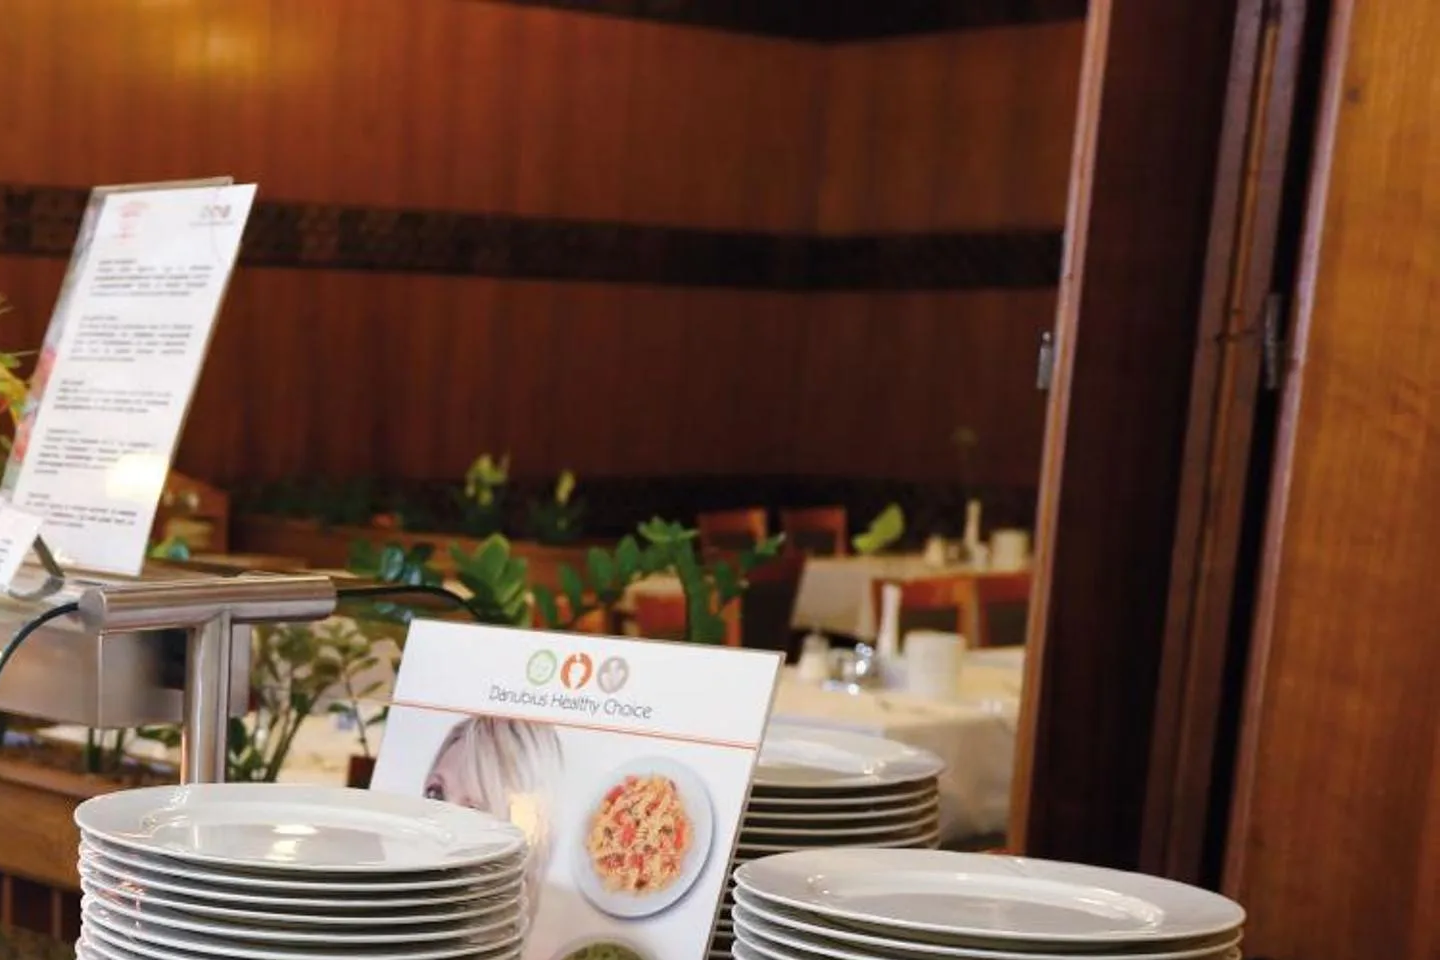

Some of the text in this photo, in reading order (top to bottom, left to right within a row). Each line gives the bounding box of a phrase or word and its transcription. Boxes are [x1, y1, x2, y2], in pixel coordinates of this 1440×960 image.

[489, 685, 653, 719] Danubius Healthy Choice
